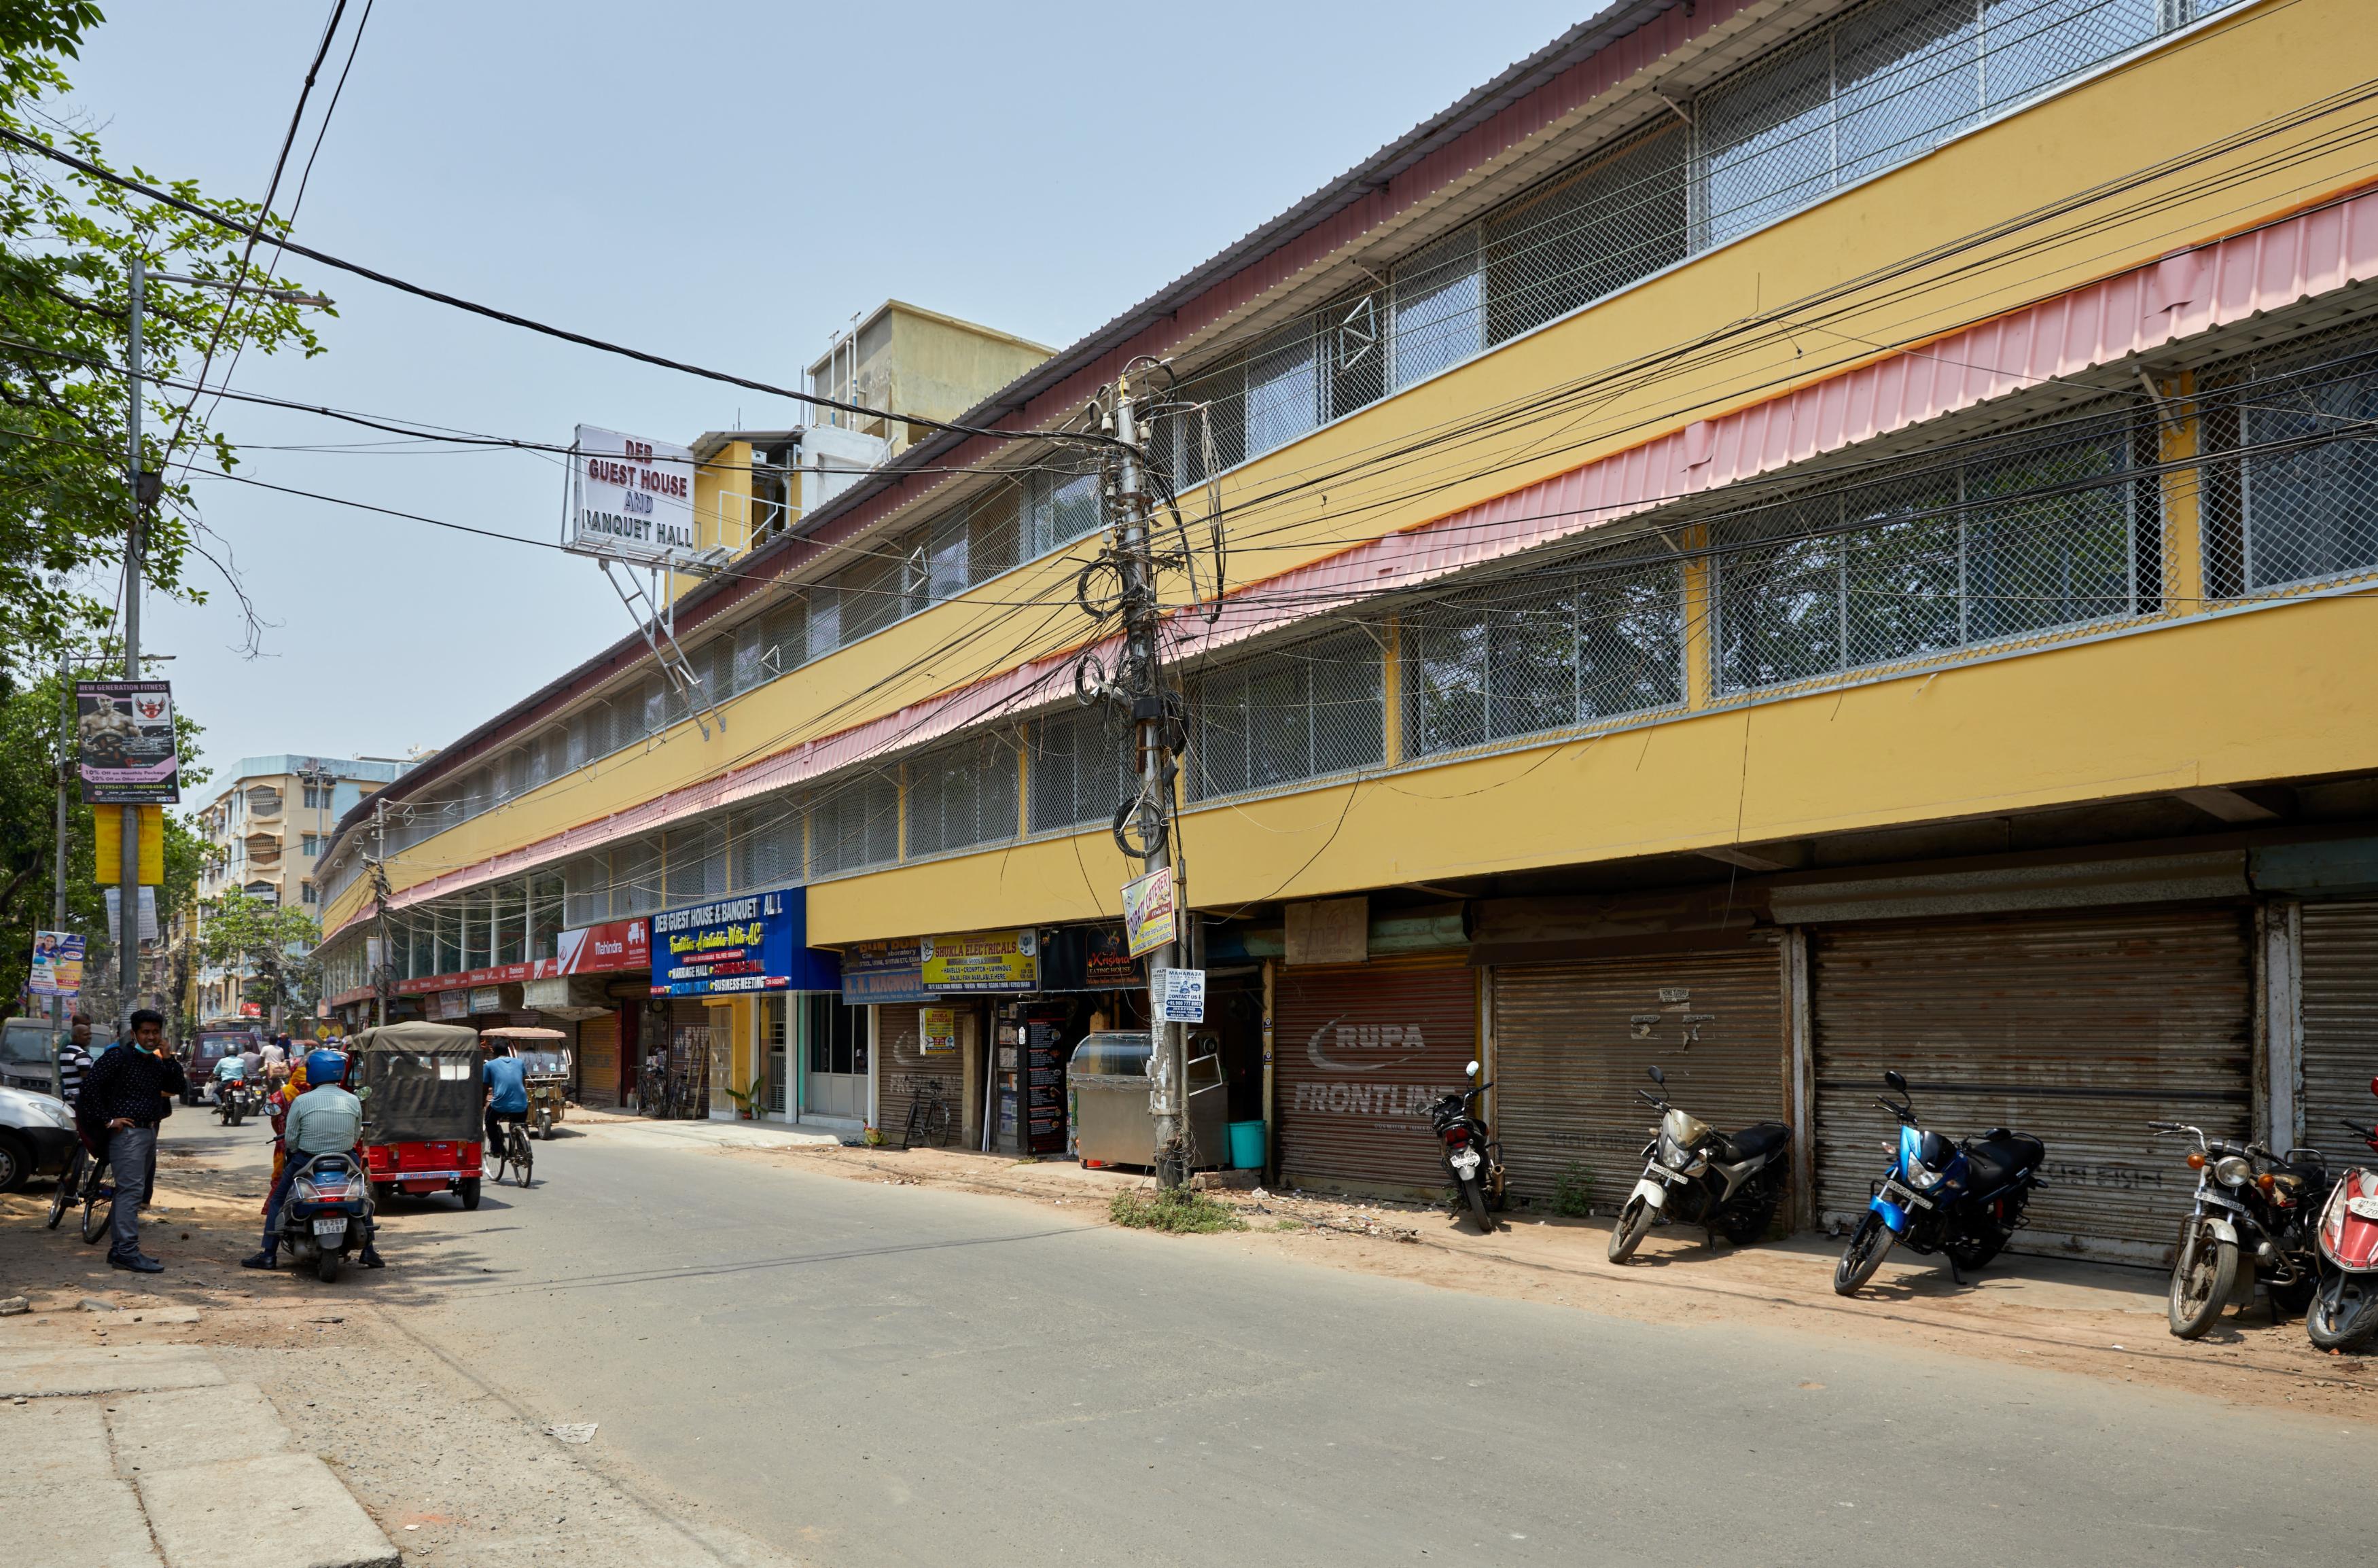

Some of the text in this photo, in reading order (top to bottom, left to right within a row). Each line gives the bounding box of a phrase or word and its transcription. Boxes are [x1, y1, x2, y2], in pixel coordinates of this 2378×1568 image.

[625, 440, 652, 464] DEB
[588, 459, 687, 497] GUEST HOUSE
[624, 491, 654, 516] AND
[656, 522, 692, 548] HALL
[1146, 872, 1168, 910] CATERER
[655, 914, 668, 933] DEB
[669, 910, 691, 930] GUEST
[691, 906, 714, 927] HOUSE
[715, 906, 721, 923] &
[722, 898, 759, 922] BANQUET
[746, 922, 763, 946] AC
[595, 940, 622, 955] Mahindra
[887, 949, 917, 957] aboratory
[936, 942, 1016, 958] SHUKLA ELECTRICALS
[1093, 951, 1131, 967] Krishna
[672, 965, 707, 979] MARRIAGE HALL
[715, 977, 740, 992] BUSINESS
[740, 976, 765, 990] MEETING
[870, 974, 922, 993] DIAGNOST
[1336, 1023, 1426, 1048] RUPA
